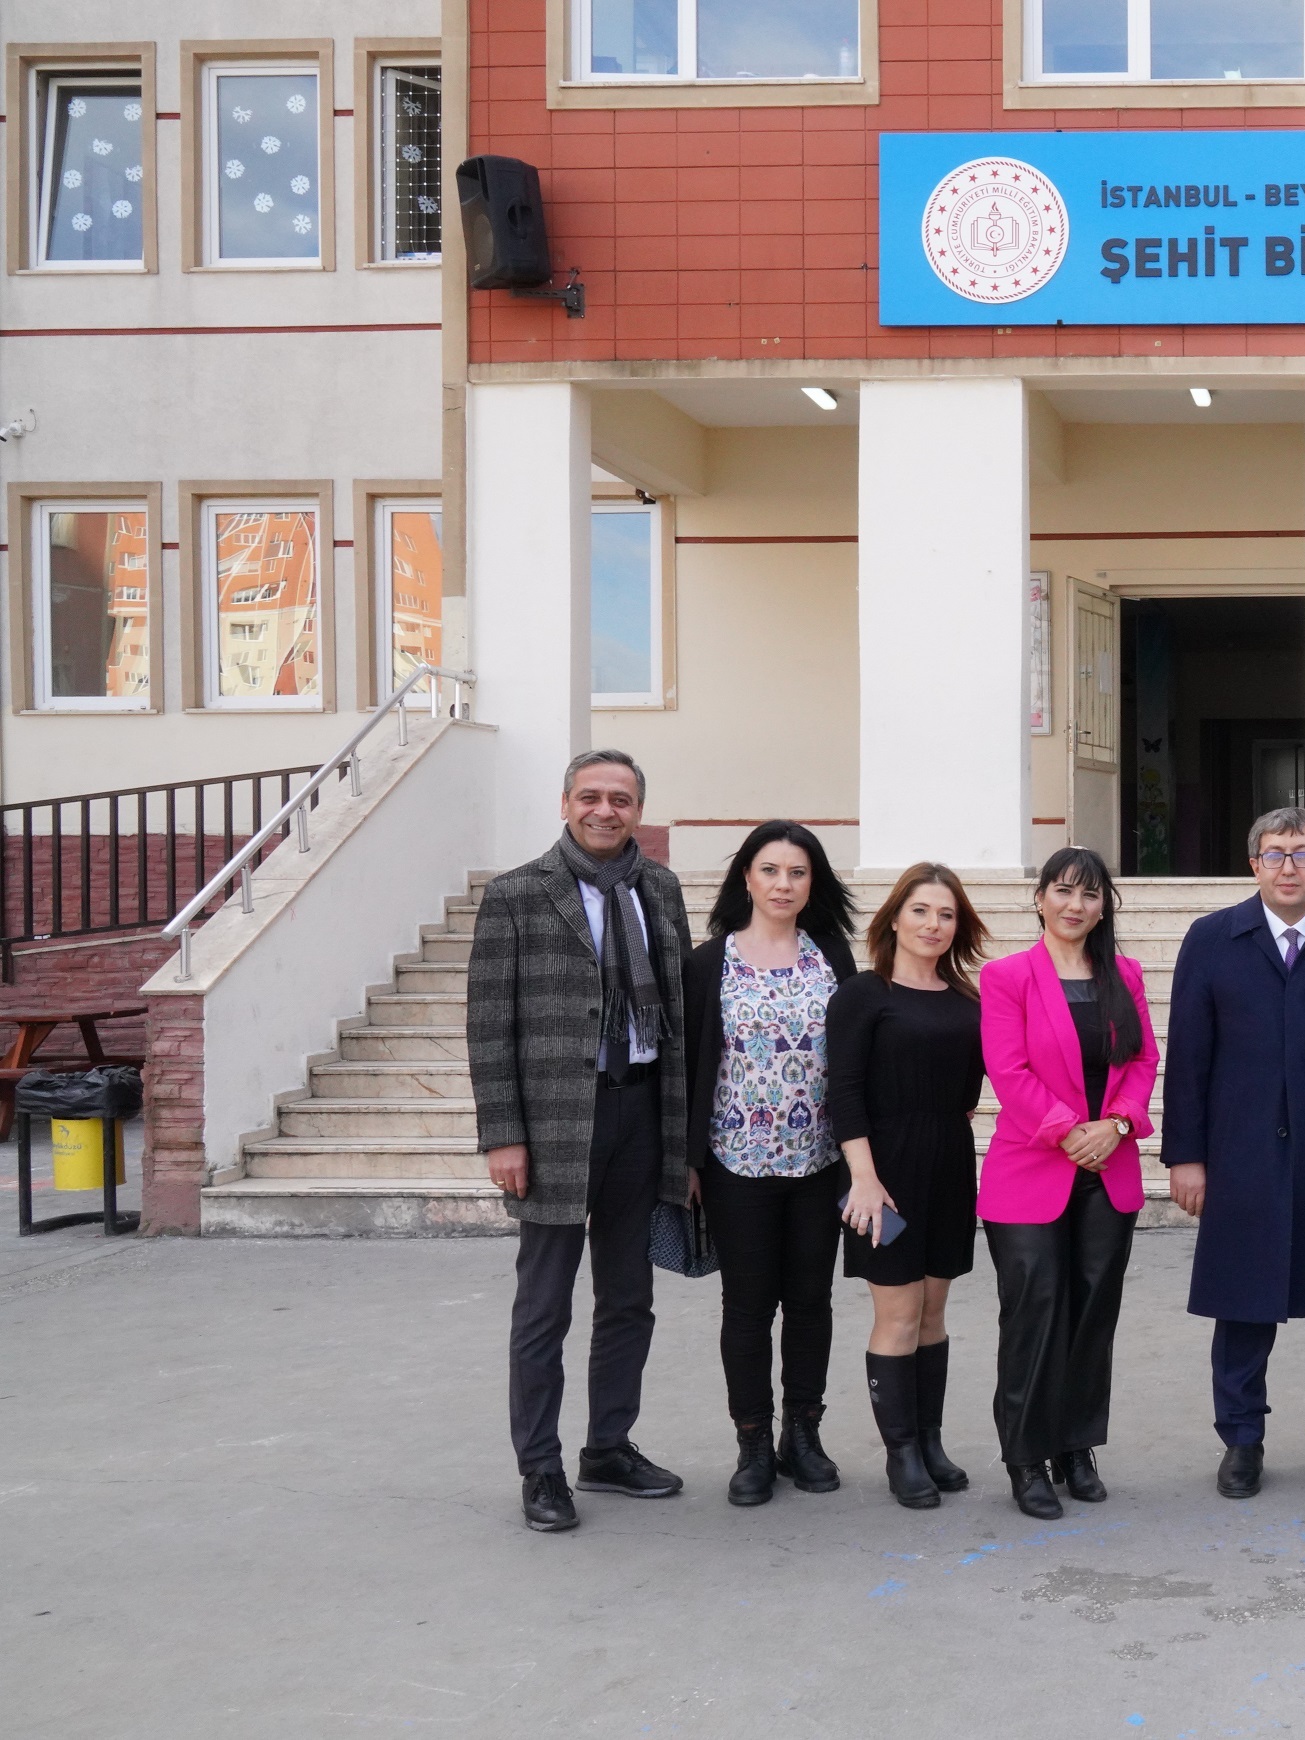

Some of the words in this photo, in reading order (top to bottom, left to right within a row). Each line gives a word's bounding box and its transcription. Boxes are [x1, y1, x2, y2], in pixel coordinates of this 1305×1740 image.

[1019, 196, 1039, 227] EĞİTİM
[1101, 180, 1238, 208] İSTANBUL
[952, 186, 989, 241] CUMHURİYETİ
[954, 244, 985, 273] TÜRKİYE
[1005, 230, 1039, 273] BAKANLIĞI
[1100, 226, 1249, 284] ŞEHİT
